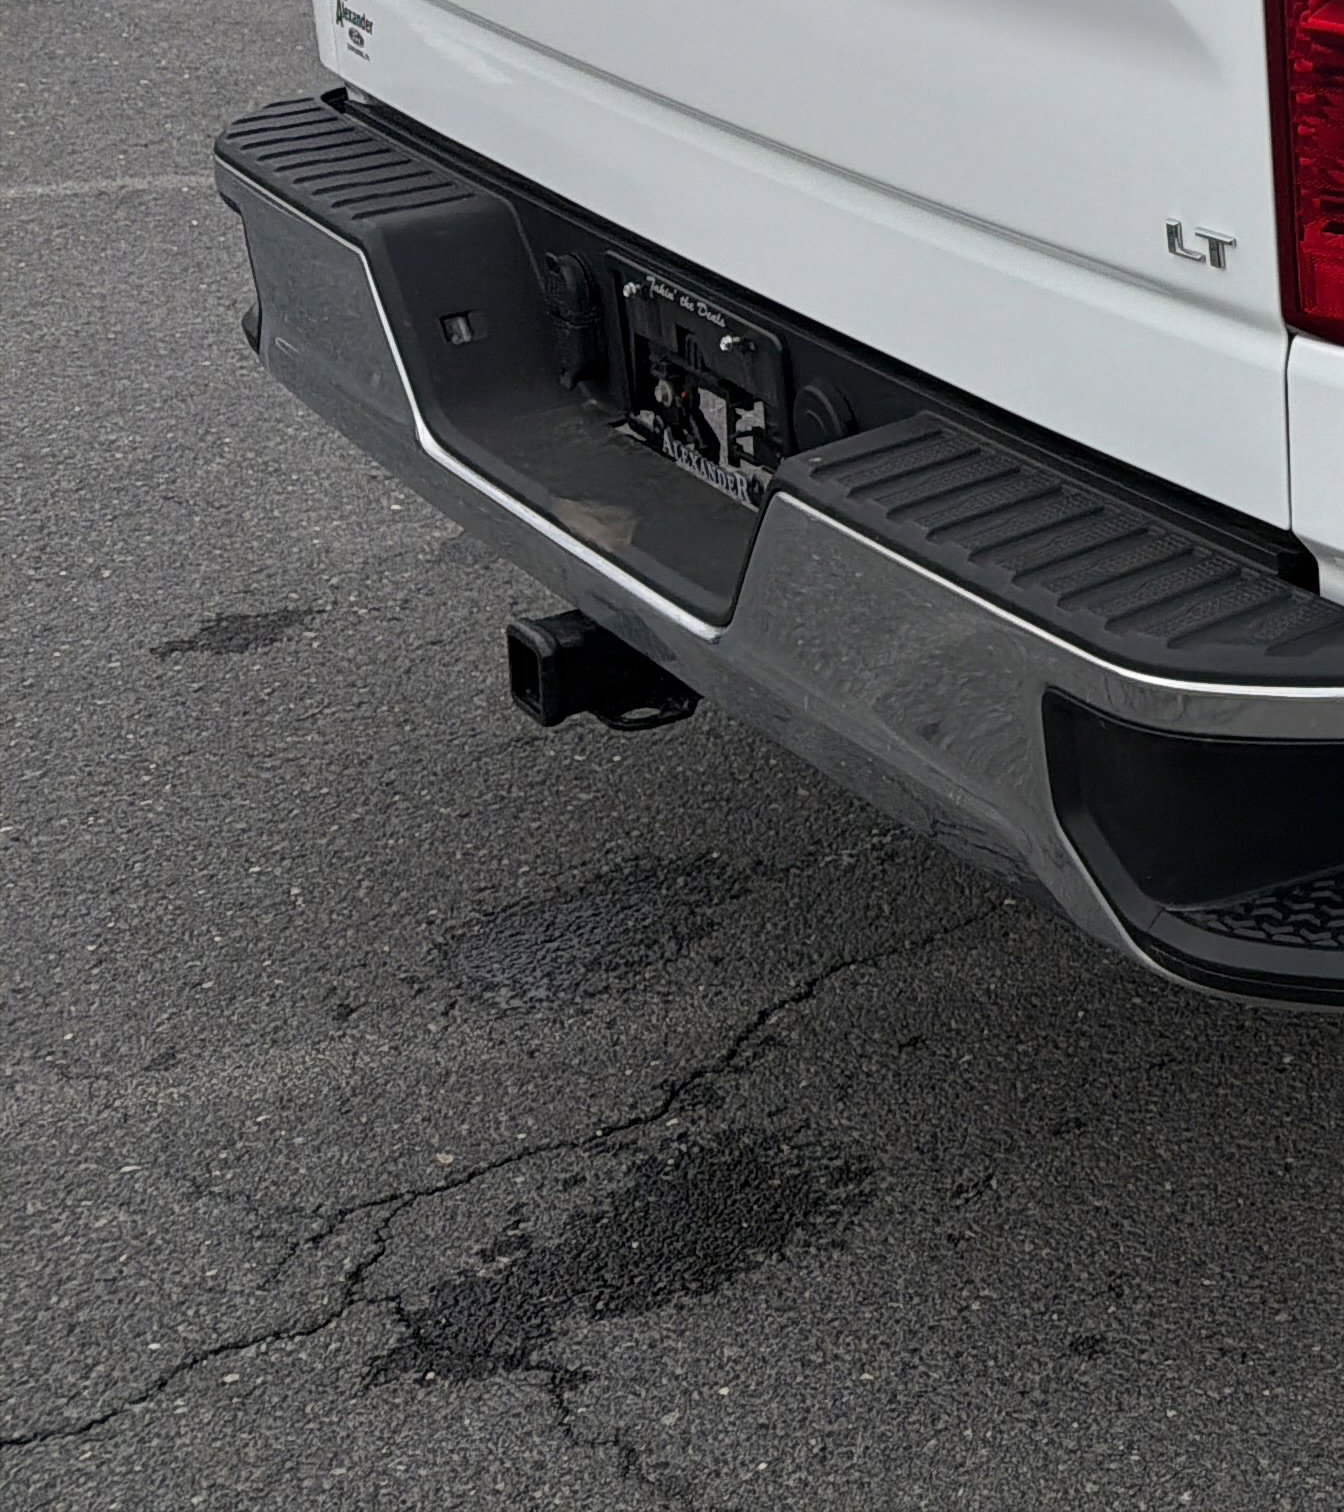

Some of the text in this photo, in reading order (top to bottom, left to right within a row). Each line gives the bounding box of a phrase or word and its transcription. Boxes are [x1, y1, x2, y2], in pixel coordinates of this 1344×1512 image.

[1165, 218, 1237, 270] LT
[680, 296, 695, 312] the
[696, 301, 726, 328] Deals
[661, 427, 751, 505] ALEXANDER
